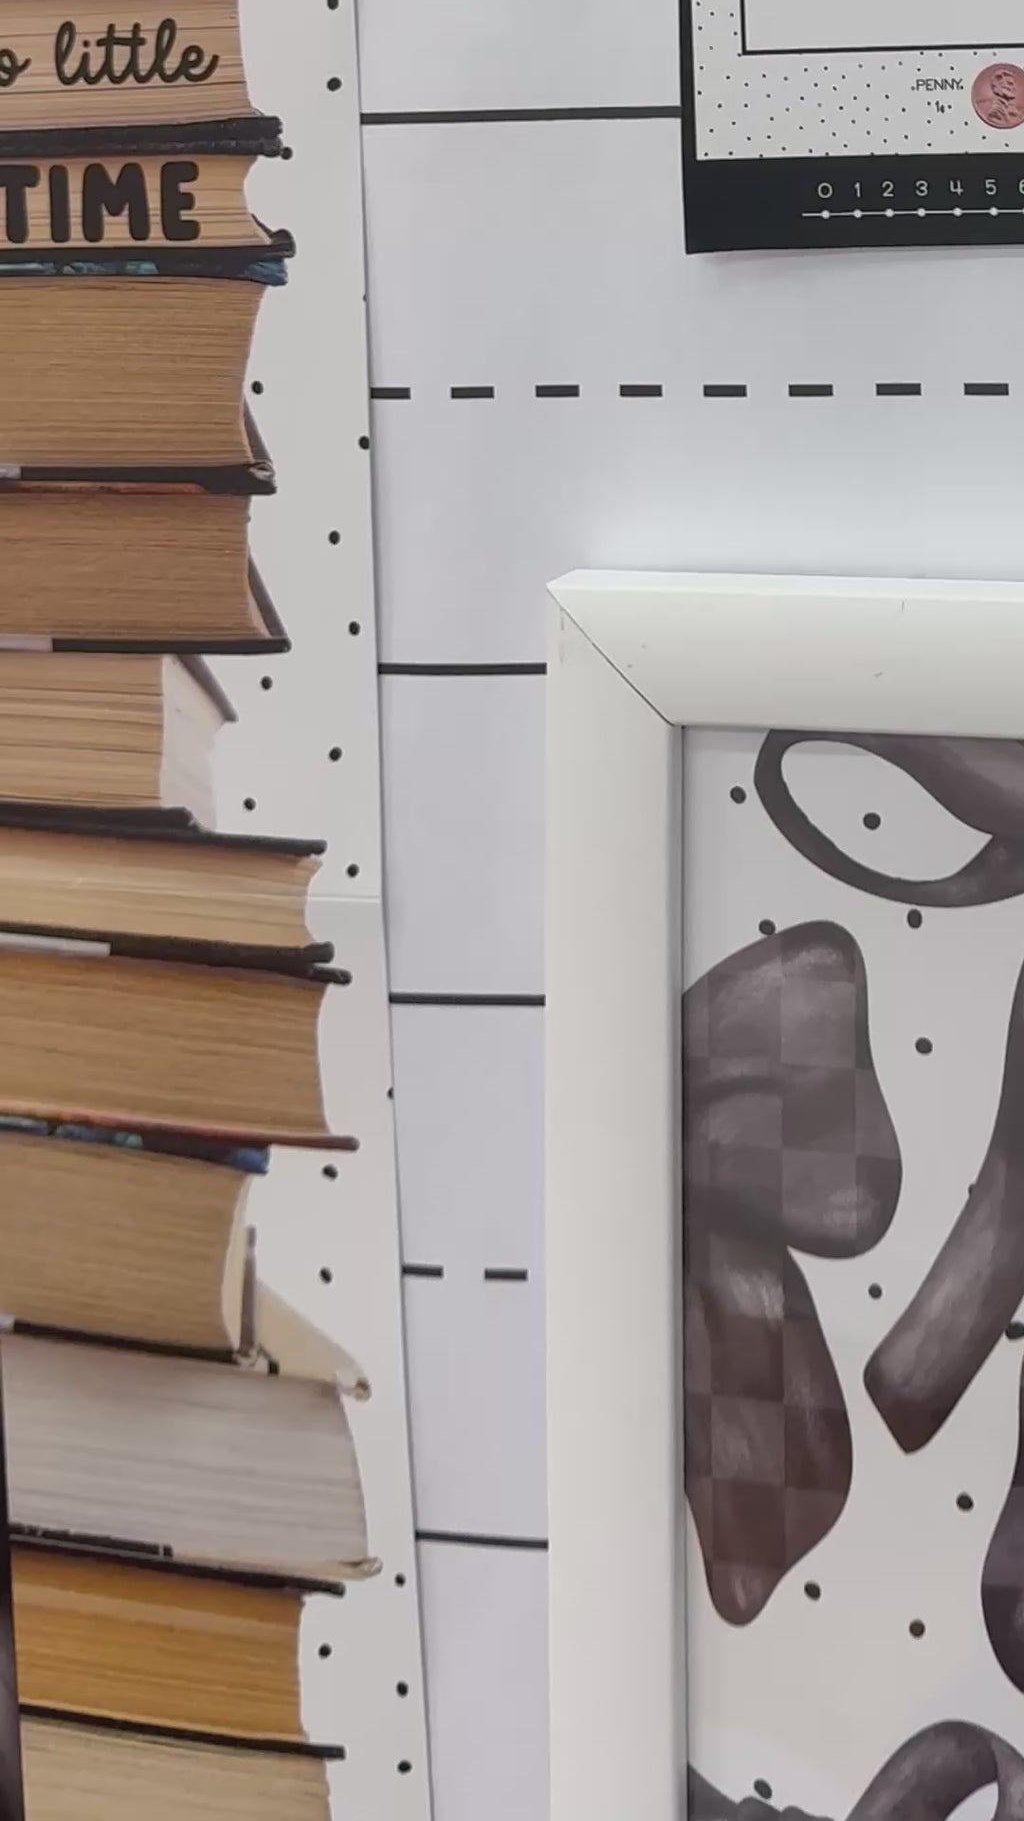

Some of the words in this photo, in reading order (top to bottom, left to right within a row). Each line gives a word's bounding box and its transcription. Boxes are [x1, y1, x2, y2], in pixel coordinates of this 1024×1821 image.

[54, 17, 219, 85] little
[916, 78, 961, 90] PENNY
[0, 160, 200, 243] TIME
[817, 182, 833, 199] 0
[854, 182, 861, 198] 1
[882, 180, 894, 197] 2
[915, 180, 928, 197] 3
[950, 180, 964, 195] 4
[985, 179, 997, 195] 5
